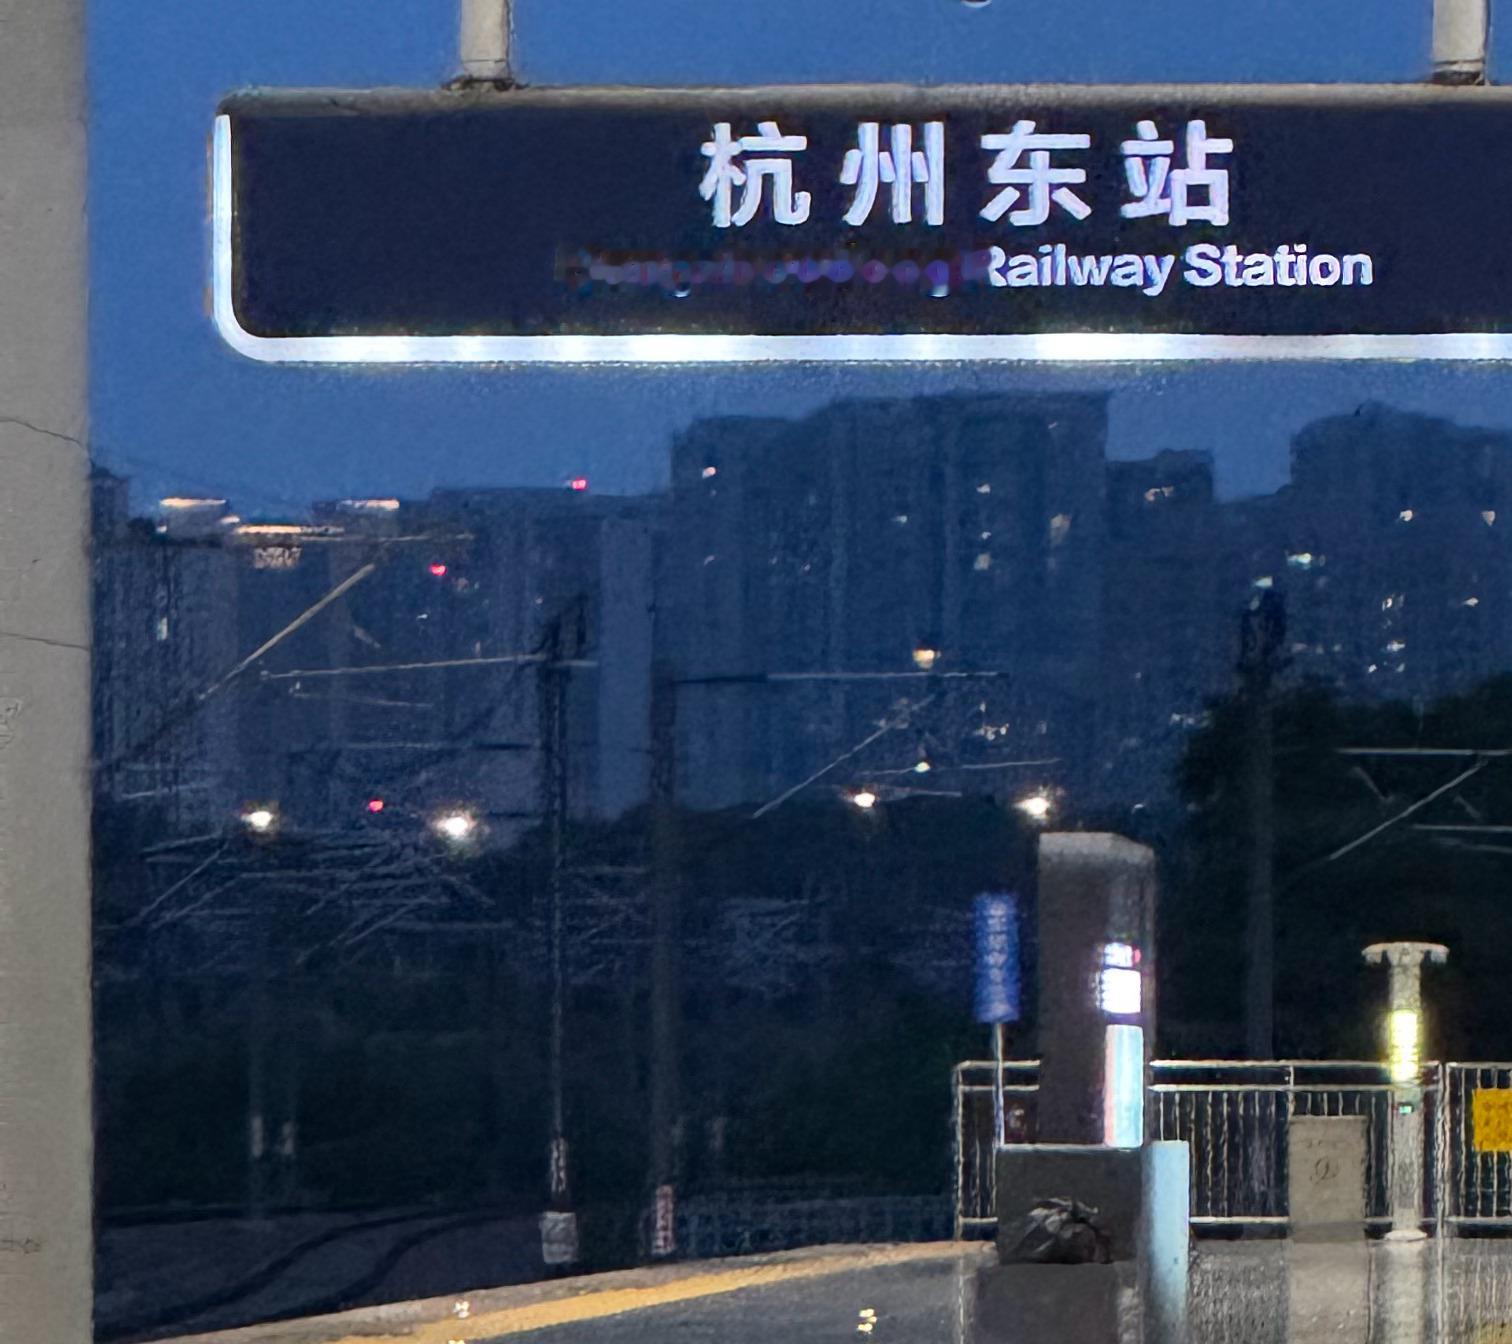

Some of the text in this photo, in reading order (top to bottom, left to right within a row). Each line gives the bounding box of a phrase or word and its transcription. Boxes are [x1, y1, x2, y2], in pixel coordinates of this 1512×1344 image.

[699, 119, 1235, 228] 杭州东站
[983, 243, 1175, 297] Railway
[1183, 243, 1375, 288] Station
